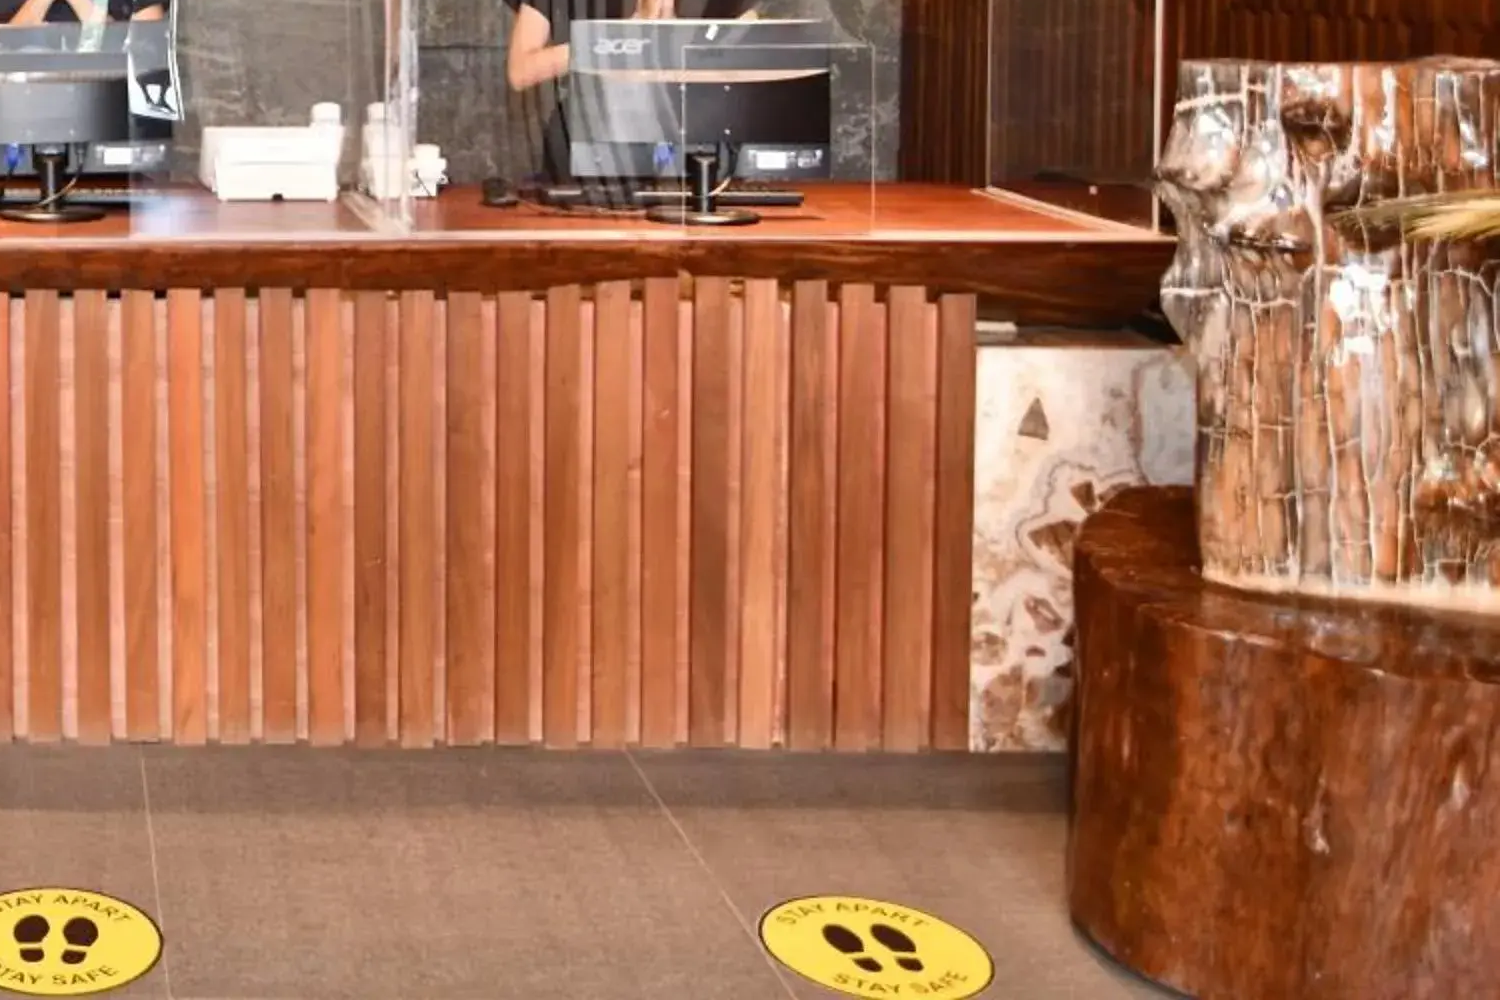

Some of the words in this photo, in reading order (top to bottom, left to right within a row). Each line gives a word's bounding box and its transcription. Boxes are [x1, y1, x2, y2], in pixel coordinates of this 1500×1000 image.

[593, 38, 651, 55] acer
[52, 894, 134, 923] APART
[775, 902, 826, 926] STAY
[835, 902, 930, 927] APART
[52, 964, 120, 986] SAFE
[832, 972, 901, 995] STAY
[908, 970, 969, 995] SAFE
